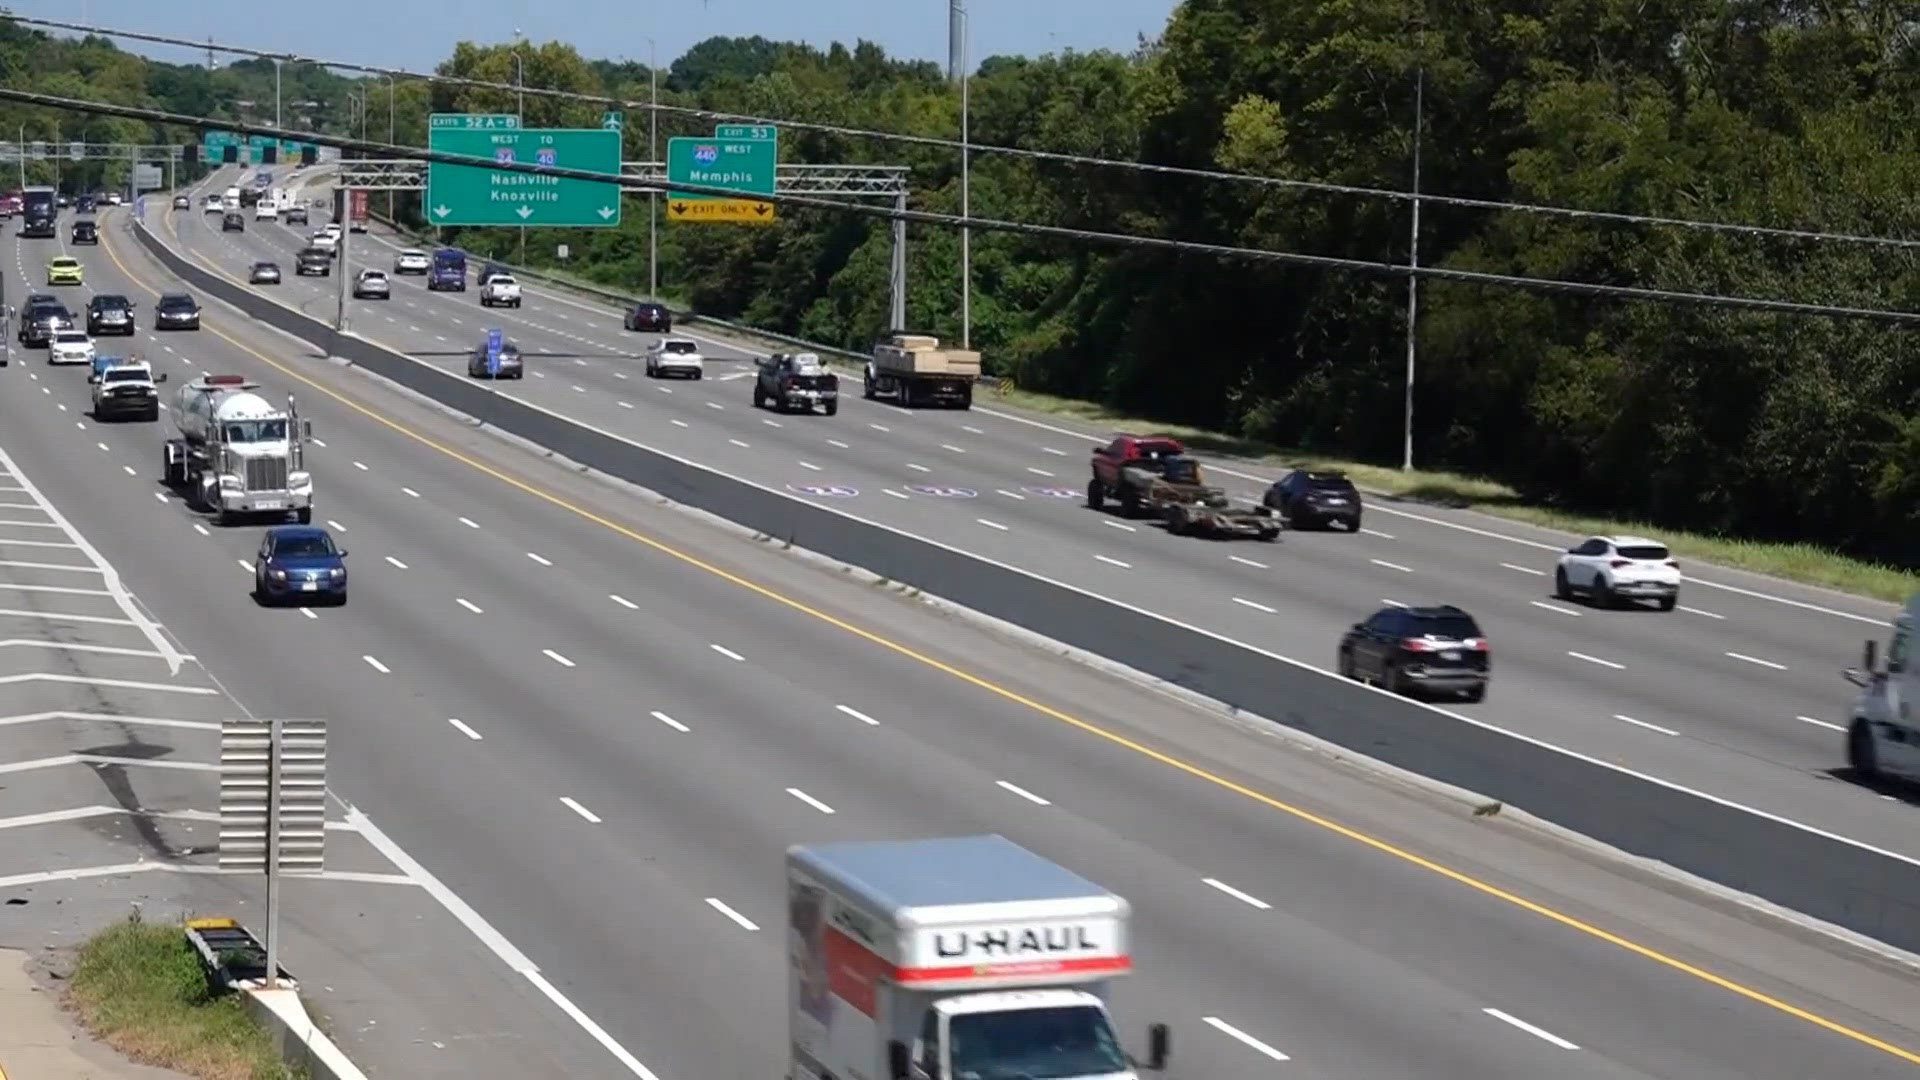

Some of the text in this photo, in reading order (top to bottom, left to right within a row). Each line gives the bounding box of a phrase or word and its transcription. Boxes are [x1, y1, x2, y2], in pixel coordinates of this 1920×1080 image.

[432, 118, 459, 126] EXITS
[724, 128, 768, 138] EXIT 53
[490, 134, 553, 144] WEST TO
[724, 145, 752, 154] WEST
[539, 154, 554, 164] 40
[695, 150, 717, 161] 440
[491, 173, 559, 185] Nashville
[689, 170, 752, 183] Memphis
[491, 190, 559, 201] Knoxville
[692, 205, 748, 214] EXIT ONLY
[935, 926, 1098, 958] U-HAUL
